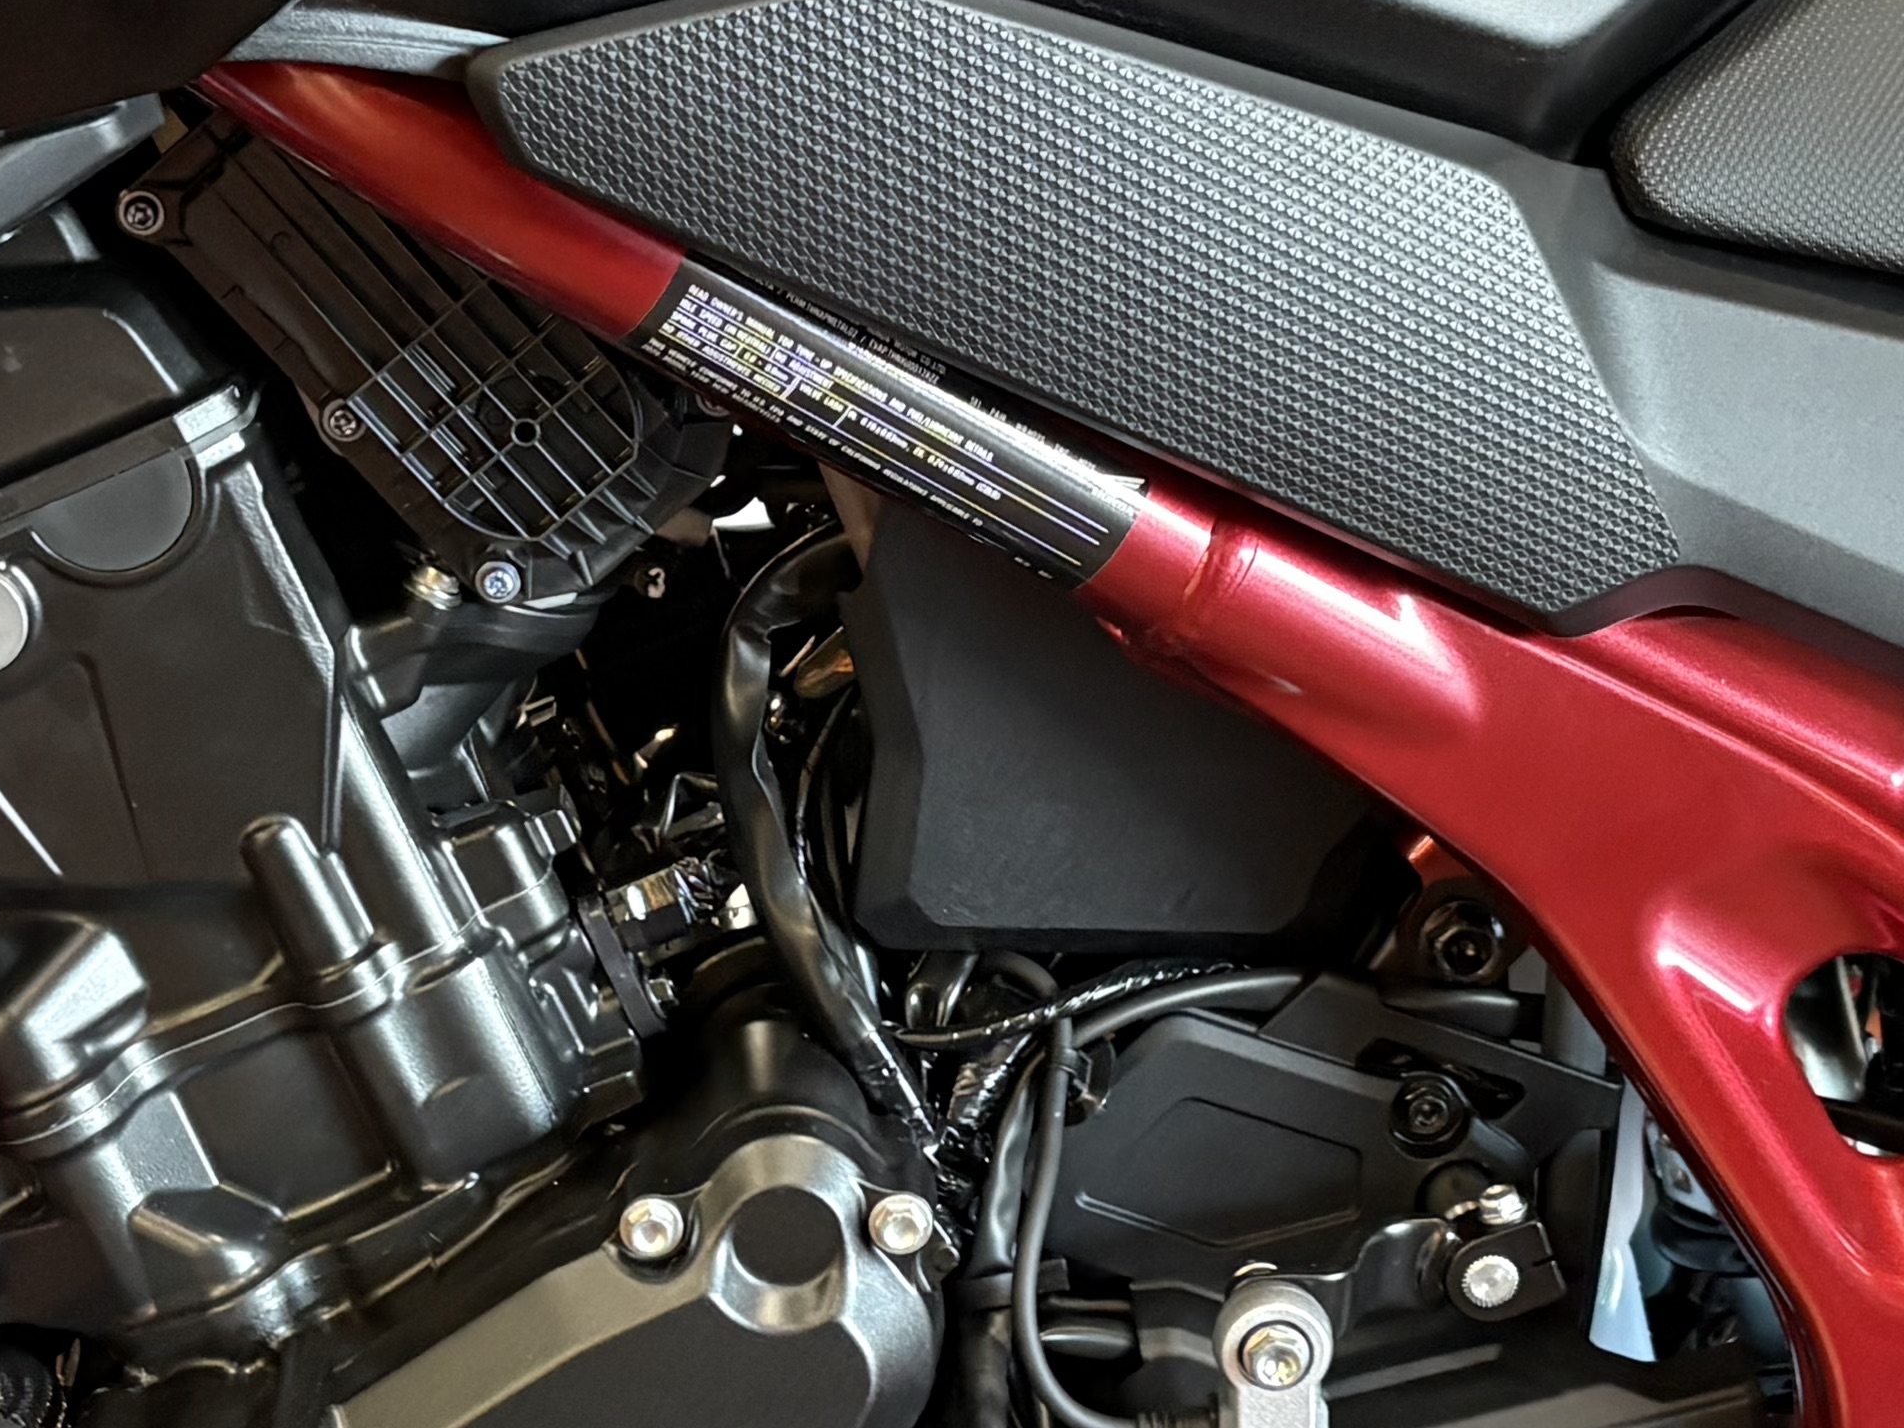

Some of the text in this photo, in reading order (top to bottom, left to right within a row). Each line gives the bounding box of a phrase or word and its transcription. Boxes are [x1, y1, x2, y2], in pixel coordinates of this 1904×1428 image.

[698, 308, 722, 327] SPEED
[788, 359, 833, 389] ADJUSTMENT
[701, 345, 751, 376] ADJUSTMENTS
[745, 316, 774, 339] MANUAL
[777, 334, 794, 348] FOR
[888, 397, 906, 412] AND
